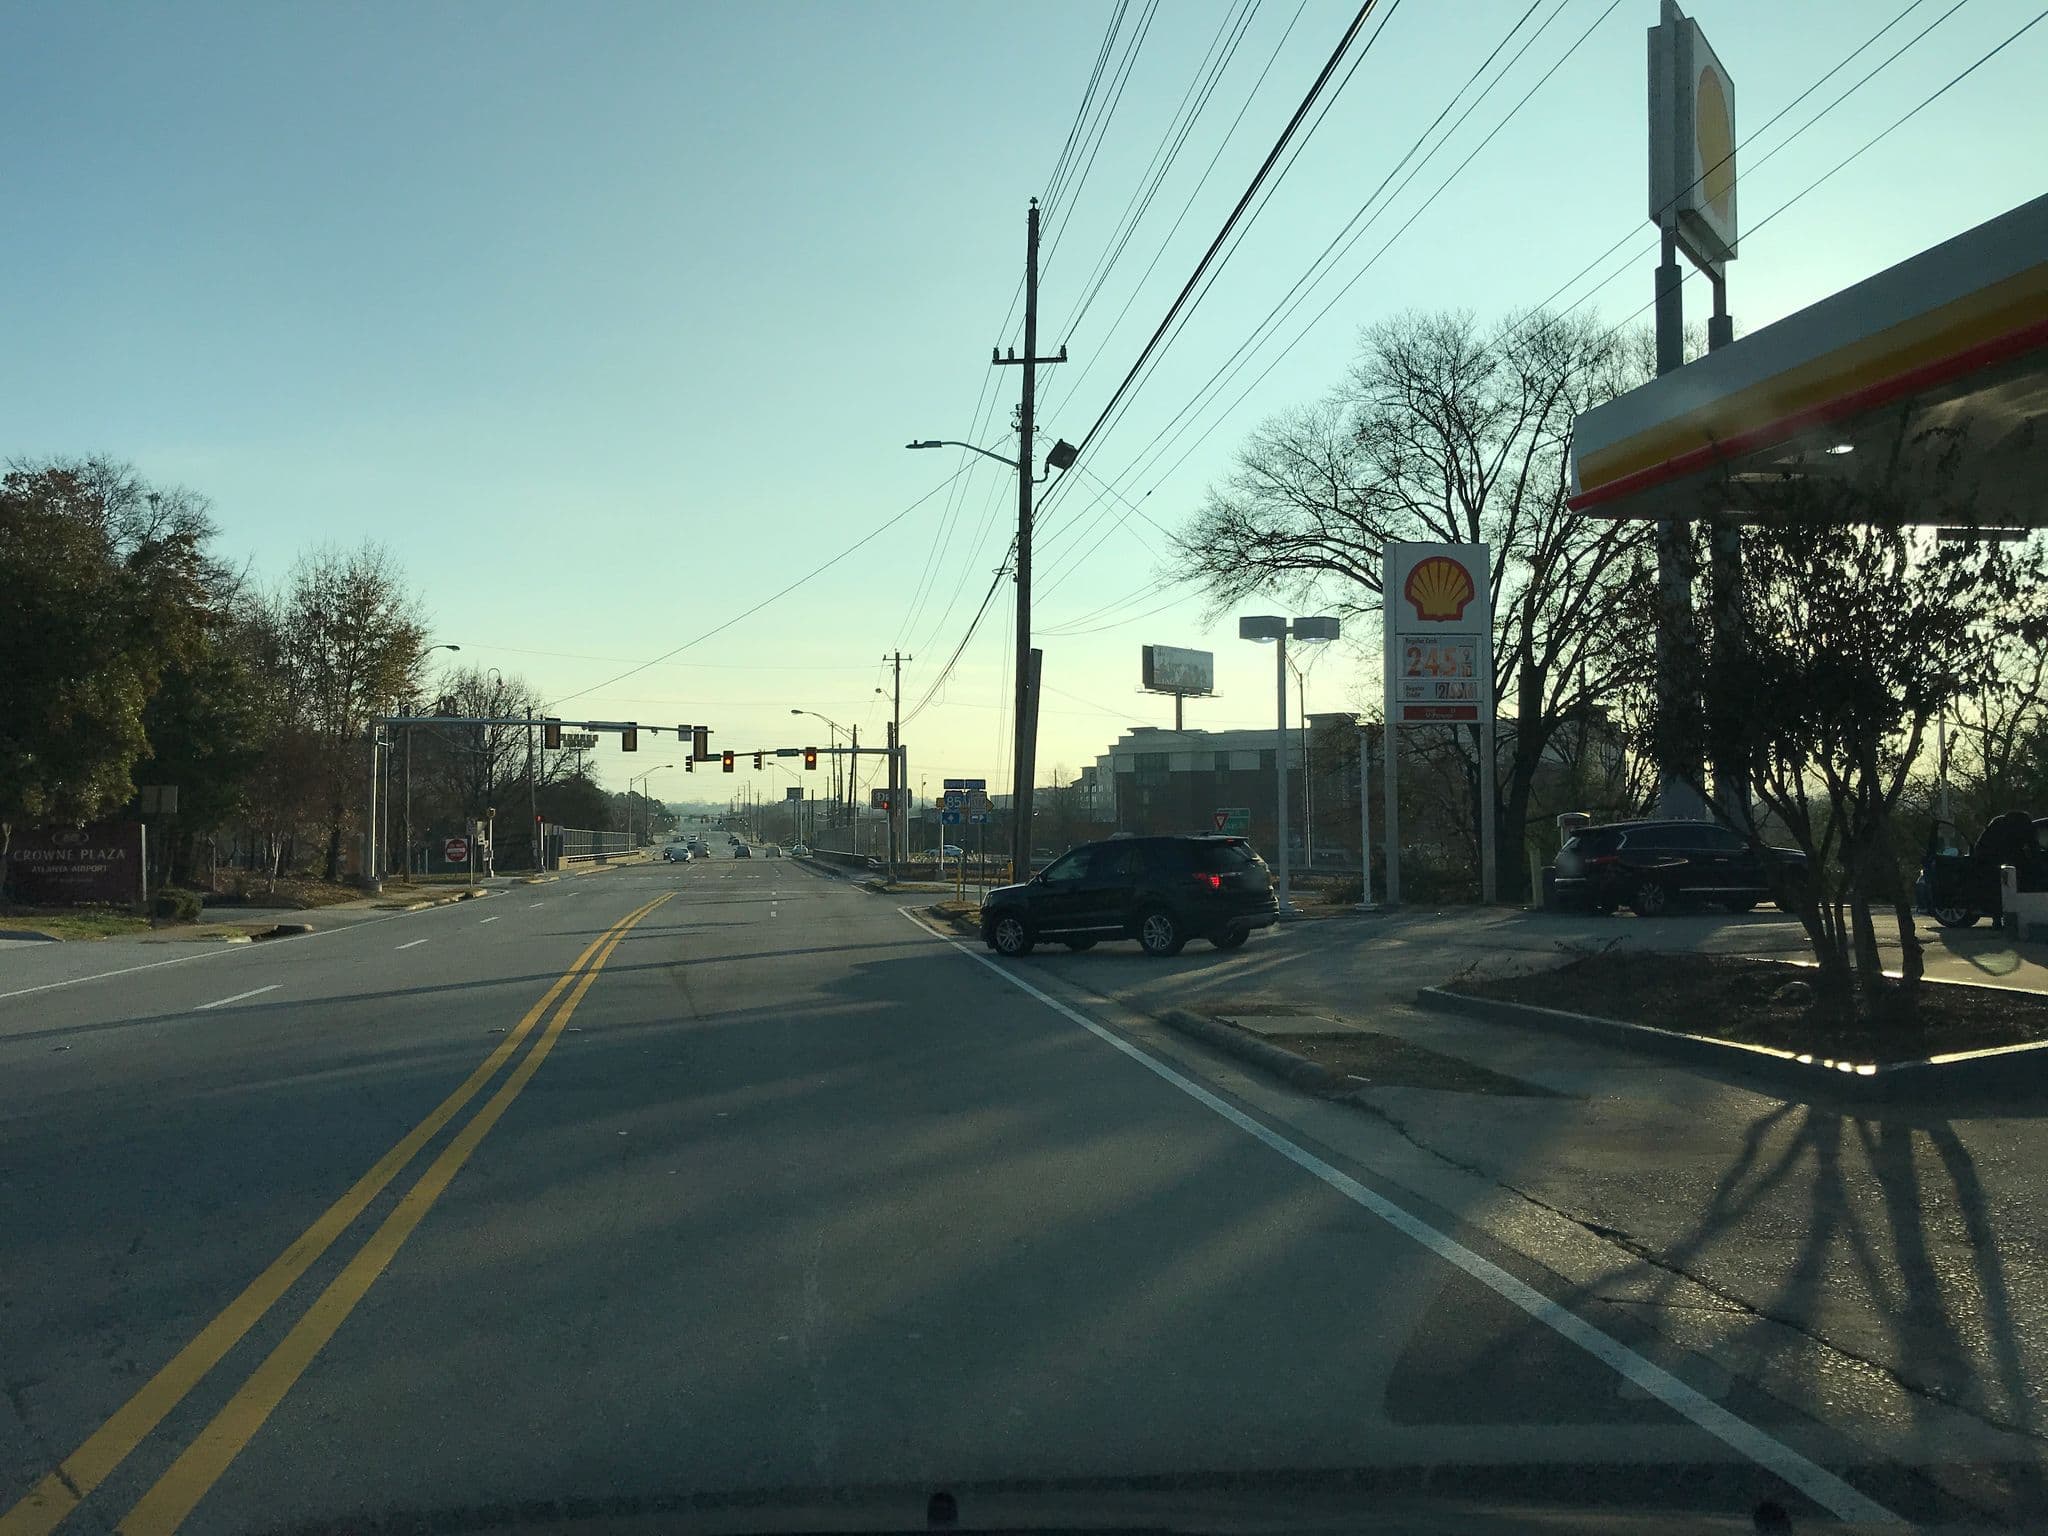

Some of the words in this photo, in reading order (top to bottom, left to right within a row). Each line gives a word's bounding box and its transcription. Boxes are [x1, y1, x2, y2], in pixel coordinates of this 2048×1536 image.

[947, 796, 961, 808] 85
[15, 849, 73, 860] CROWNE
[80, 849, 125, 860] PLAZA
[71, 864, 107, 873] AIRPORT
